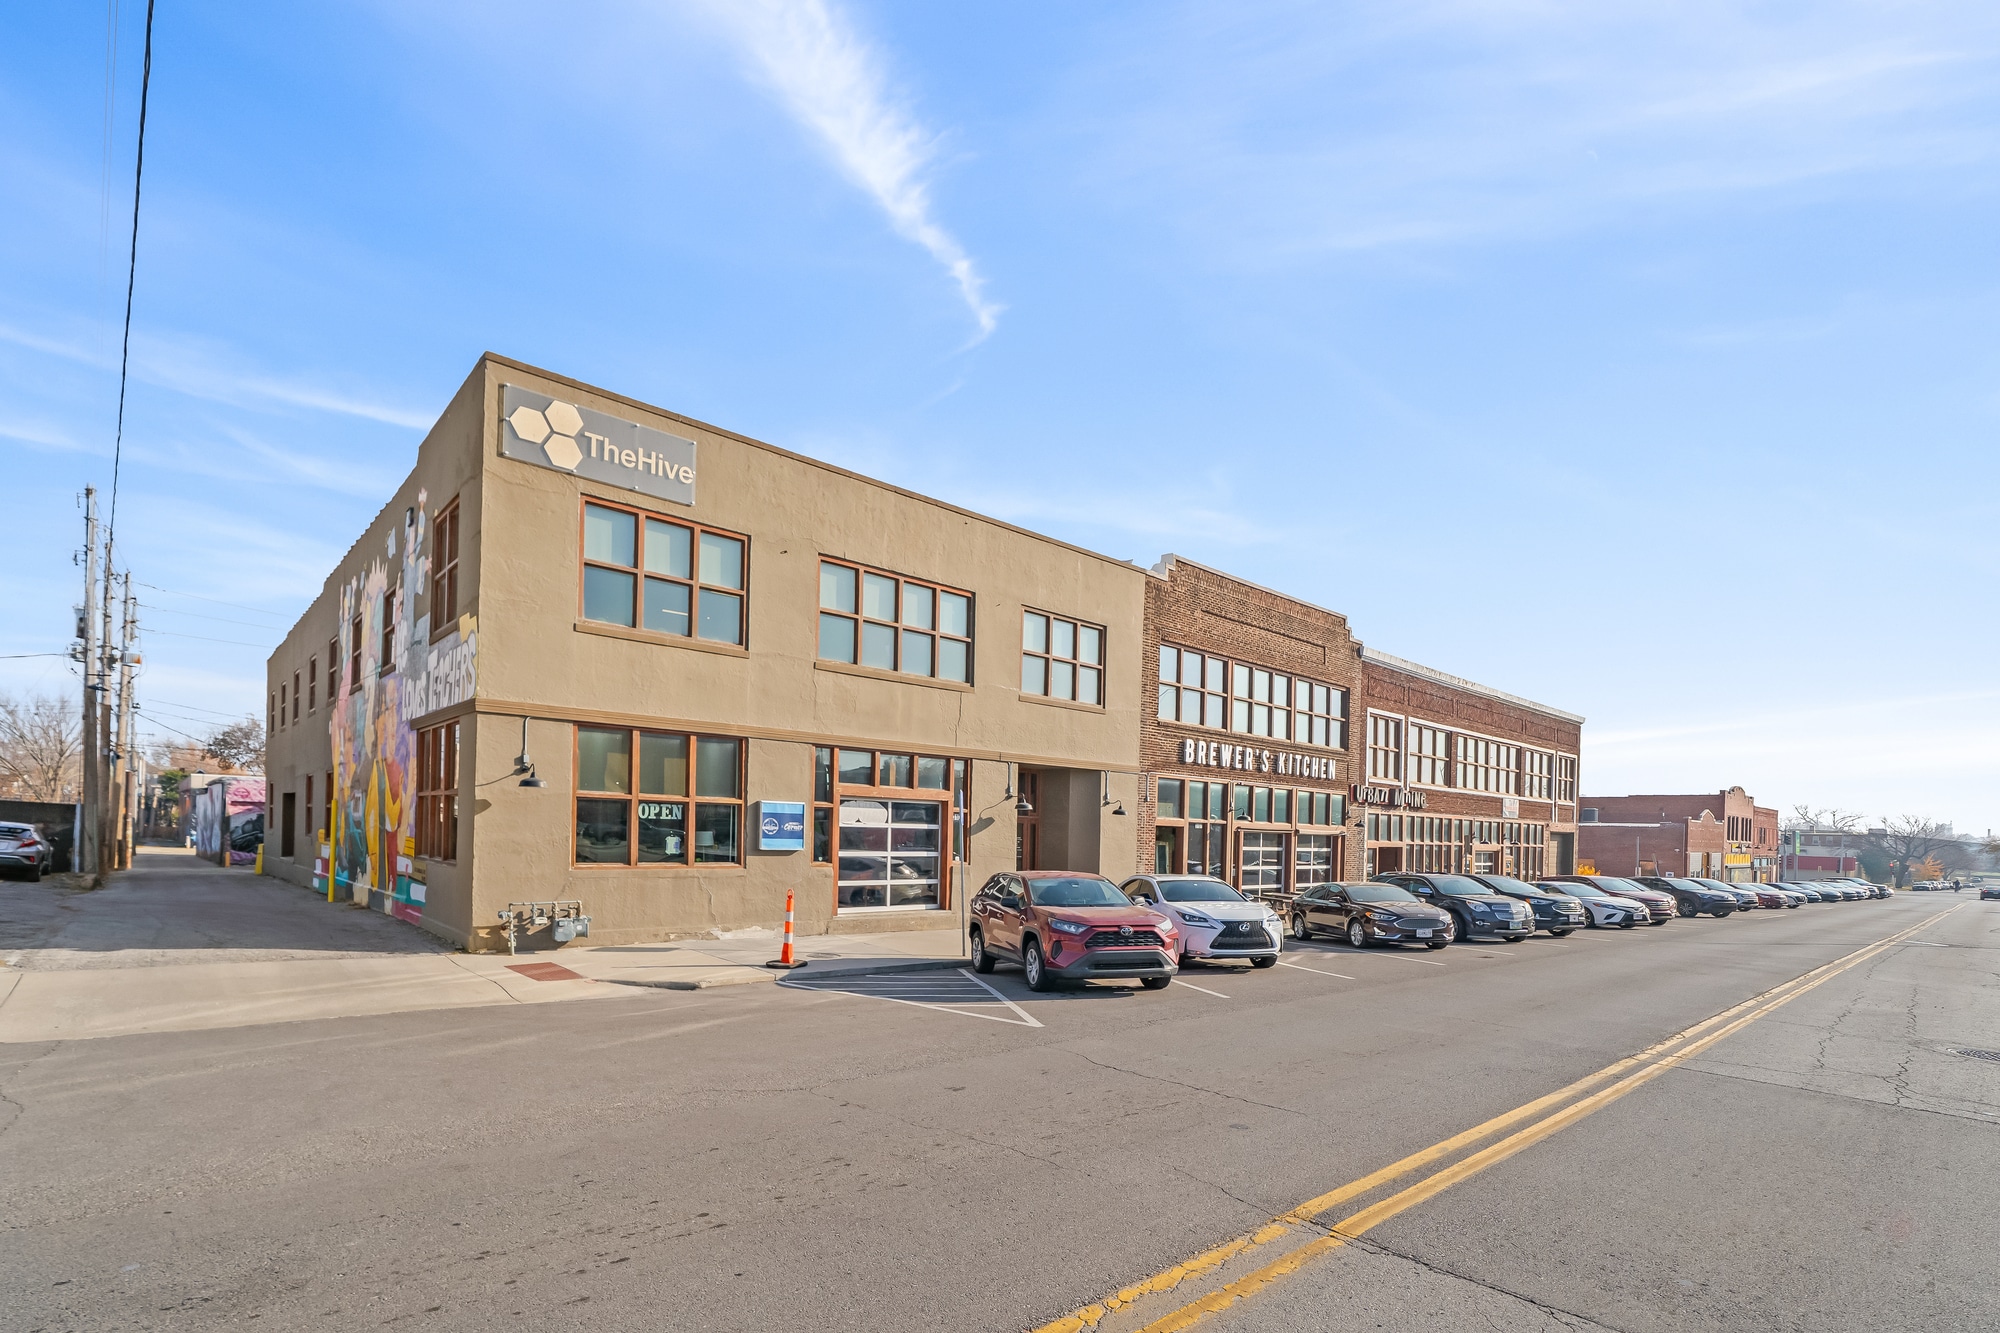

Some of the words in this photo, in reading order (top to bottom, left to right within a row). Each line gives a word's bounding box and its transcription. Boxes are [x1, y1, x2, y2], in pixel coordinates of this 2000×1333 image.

[584, 432, 694, 484] TheHive
[427, 629, 477, 711] TEACHERS
[1184, 738, 1269, 773] BREWER'S
[1277, 752, 1336, 780] KITCHEN
[638, 803, 683, 819] OPEN
